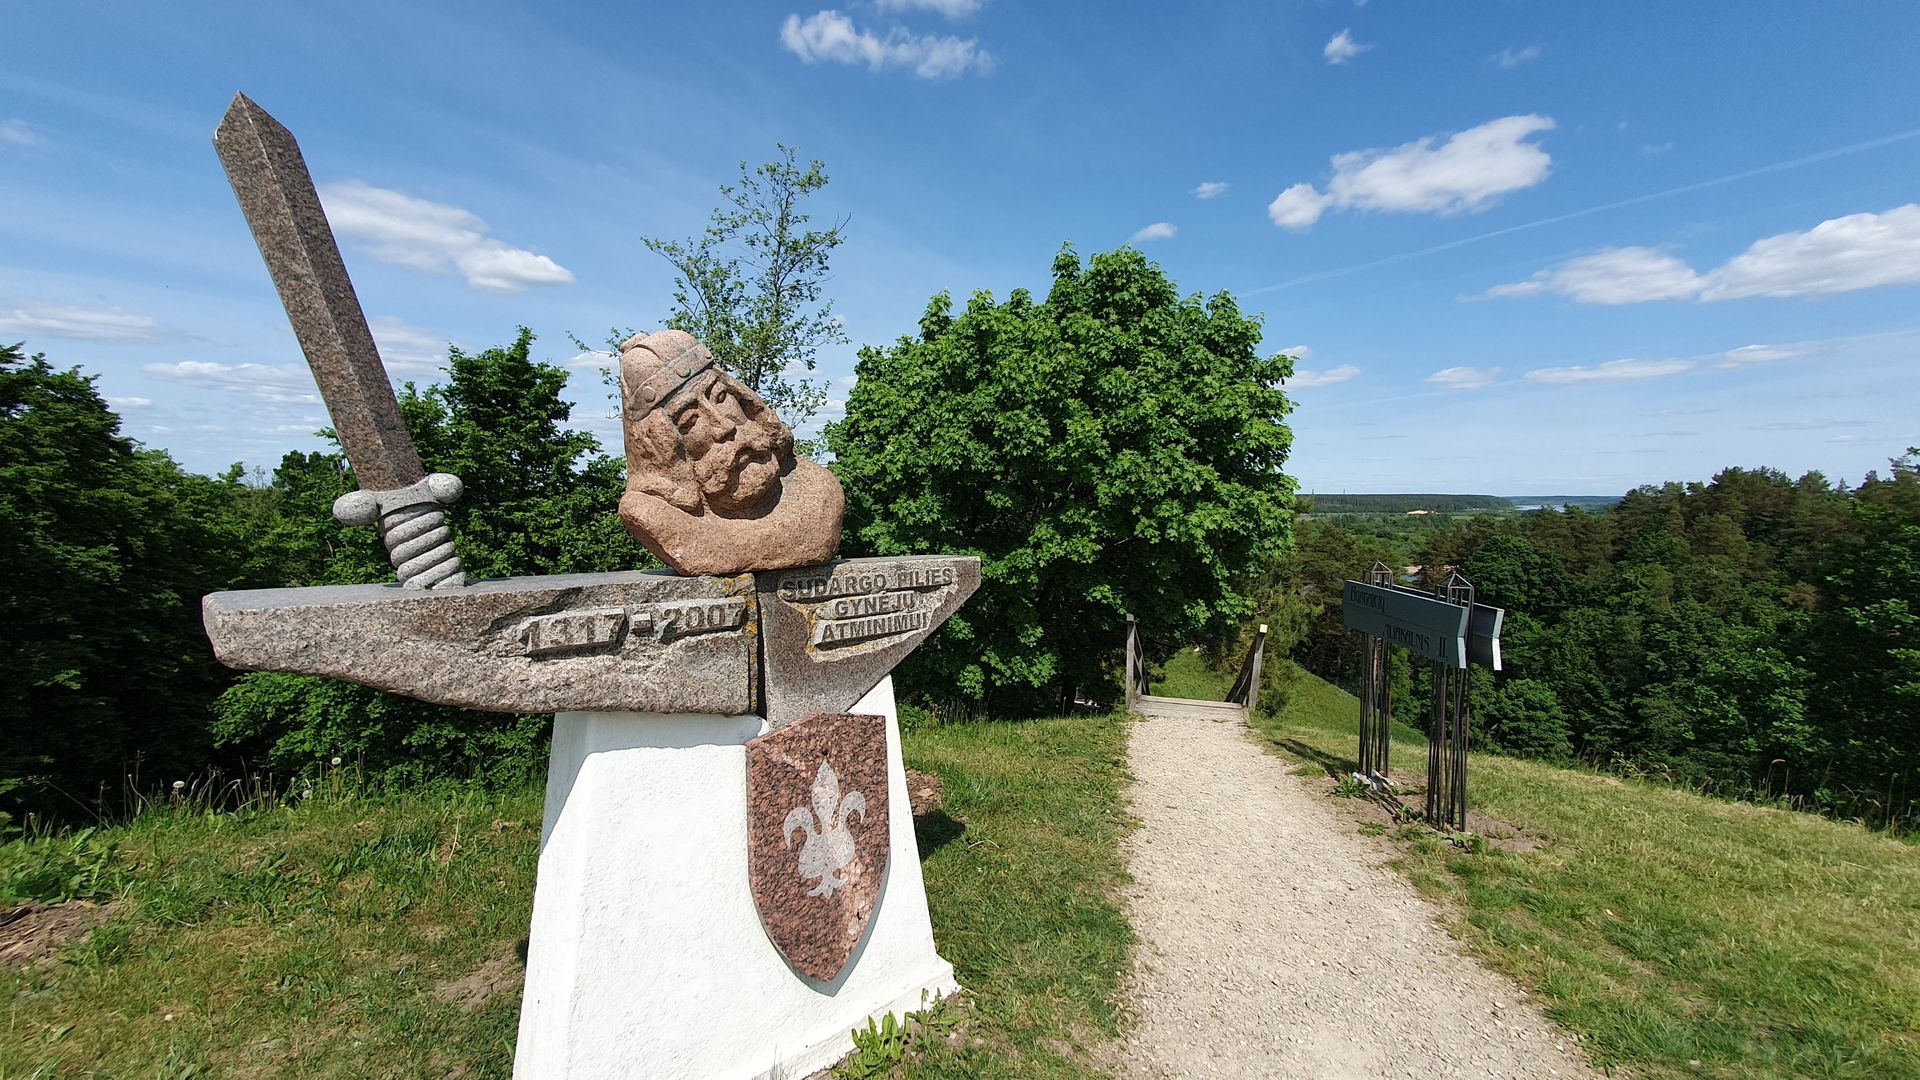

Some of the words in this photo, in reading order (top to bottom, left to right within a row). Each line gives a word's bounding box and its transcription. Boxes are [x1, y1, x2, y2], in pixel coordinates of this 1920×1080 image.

[782, 573, 887, 599] SUDARGO
[897, 566, 954, 588] PILIES
[822, 611, 928, 643] ATMINIMUI
